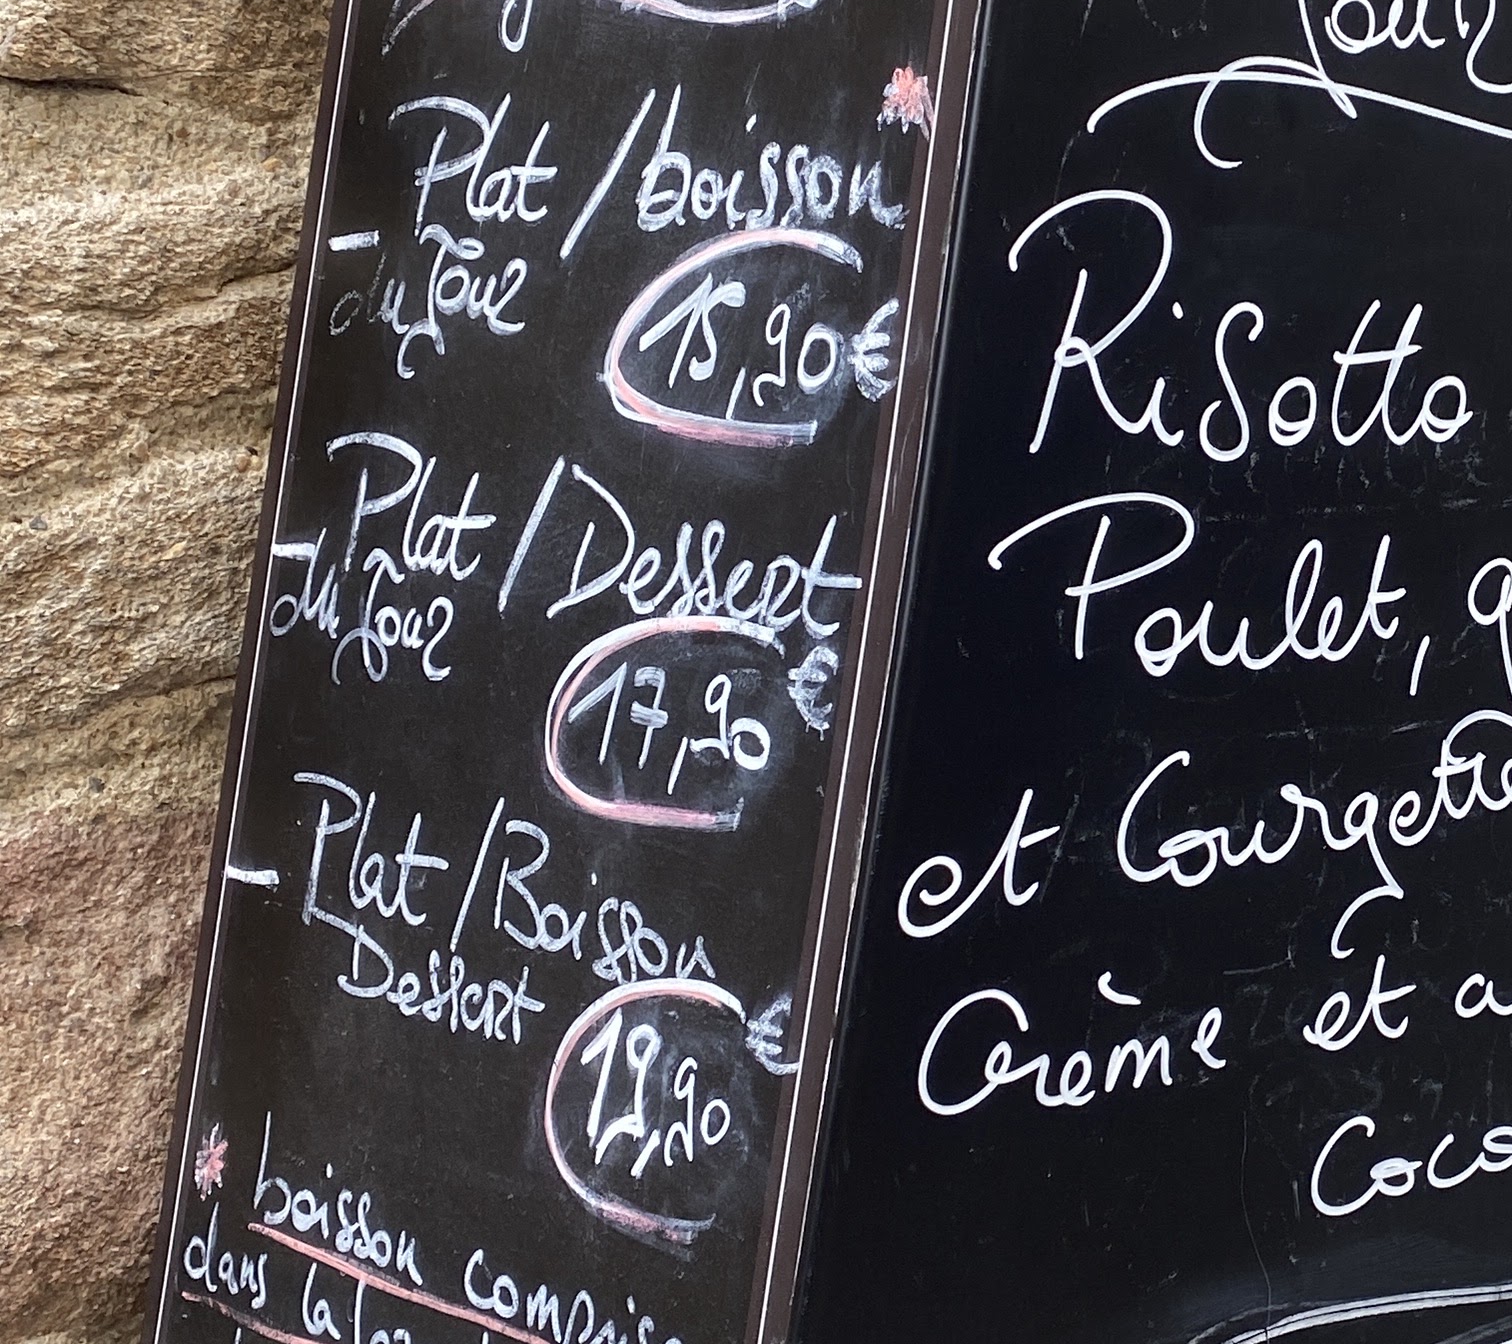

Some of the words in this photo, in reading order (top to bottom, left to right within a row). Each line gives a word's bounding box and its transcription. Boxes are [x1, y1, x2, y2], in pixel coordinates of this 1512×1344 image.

[987, 492, 1430, 696] Poulet,
[897, 787, 1061, 938] et
[336, 924, 546, 1045] Dessert
[917, 971, 1227, 1116] Crème
[1302, 953, 1417, 1051] et
[183, 1200, 269, 1310] dans
[301, 1261, 343, 1342] la
[253, 1110, 424, 1287] boisson
